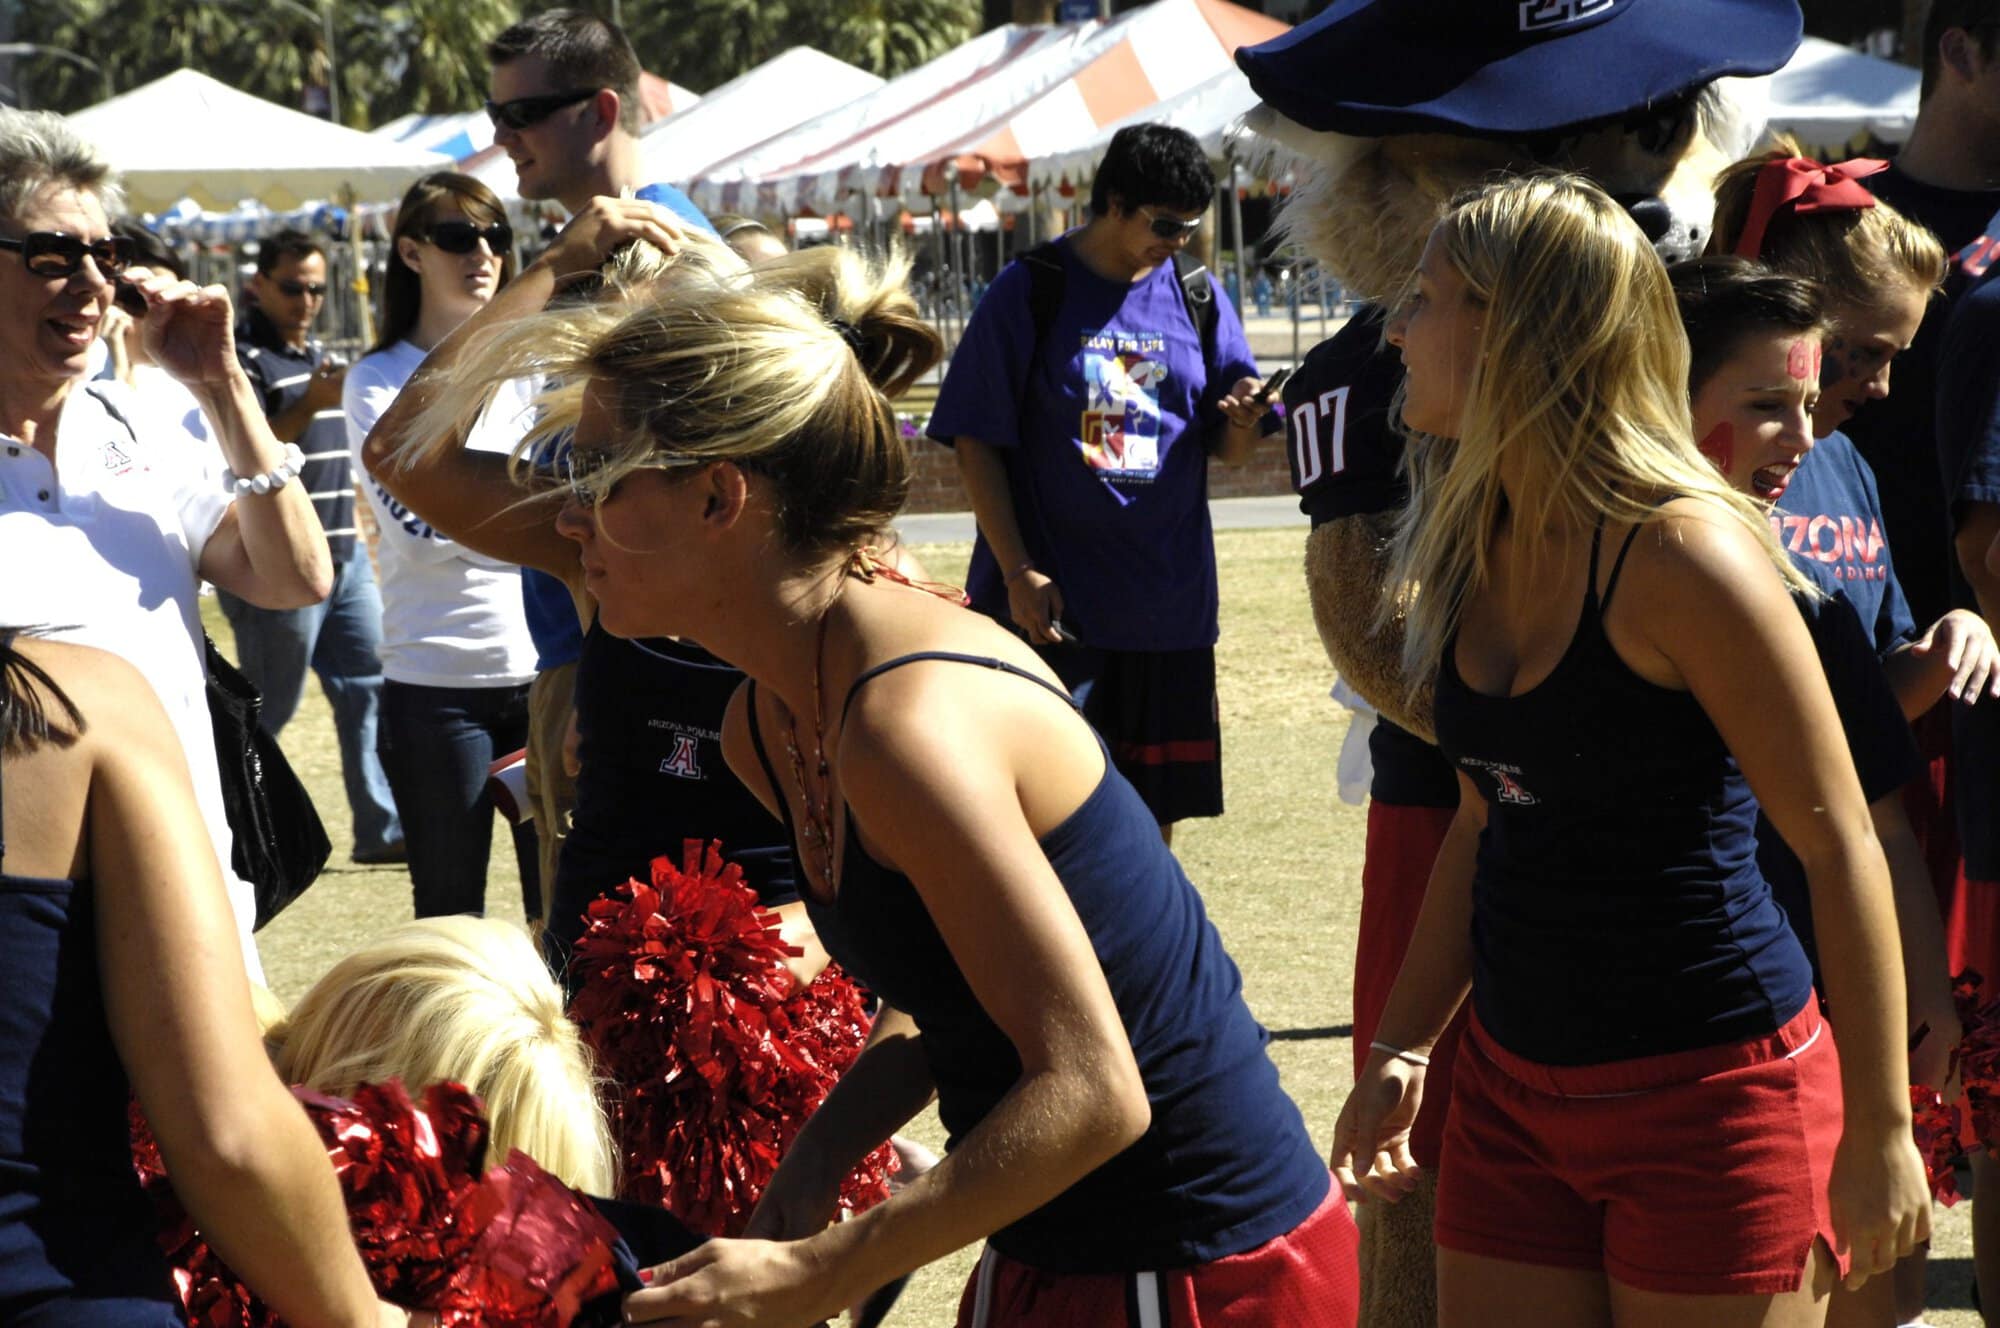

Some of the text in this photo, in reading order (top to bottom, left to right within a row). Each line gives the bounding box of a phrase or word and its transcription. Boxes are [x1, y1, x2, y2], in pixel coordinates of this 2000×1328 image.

[1118, 340, 1138, 352] FOR
[1292, 385, 1351, 490] 07
[1768, 515, 1885, 563] IZONA
[1834, 565, 1888, 581] ADING
[659, 732, 701, 780] A
